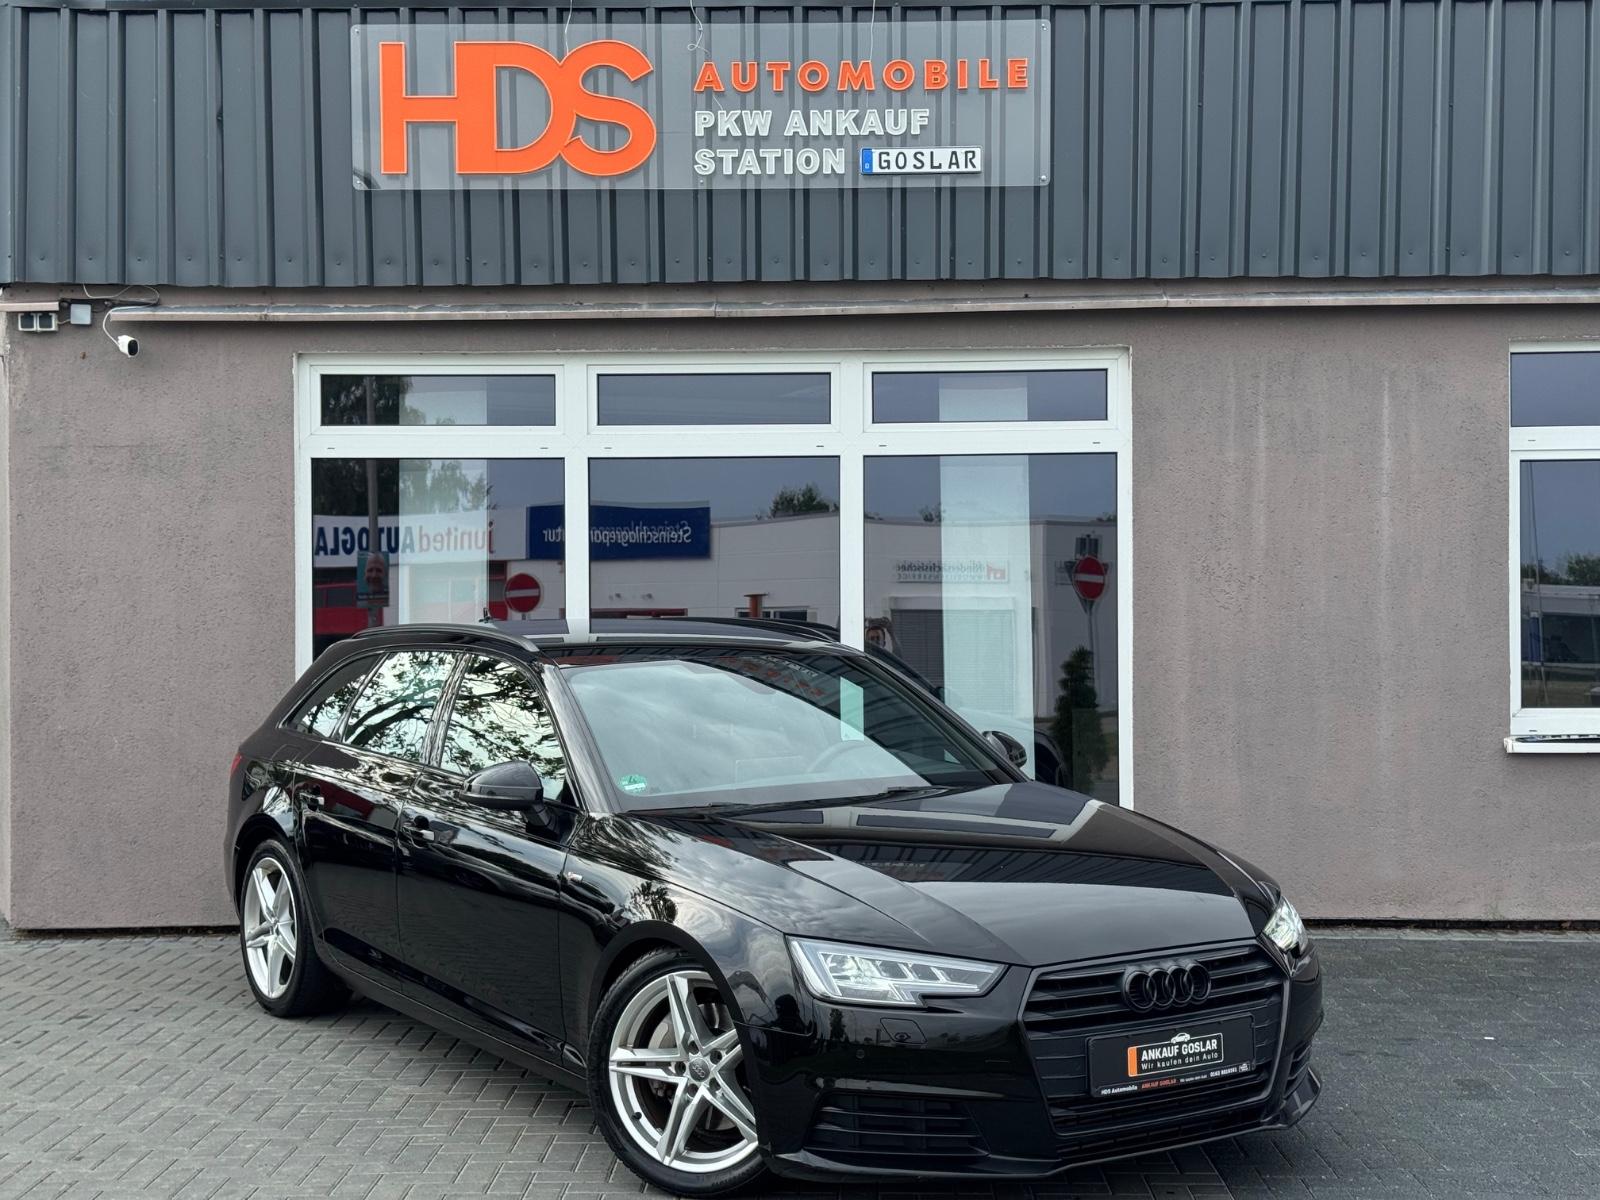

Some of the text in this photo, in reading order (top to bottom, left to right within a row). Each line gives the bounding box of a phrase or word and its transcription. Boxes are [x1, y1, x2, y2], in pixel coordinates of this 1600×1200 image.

[694, 58, 1029, 92] AUTOMOBILE
[379, 39, 657, 176] HDS
[694, 108, 930, 137] PKW ANKAUF
[693, 148, 845, 175] STATION
[878, 150, 977, 170] GOSLAR
[1141, 1039, 1218, 1061] ANKAUF GOSLAR
[1141, 1052, 1219, 1070] Wir kaufen dein Auto
